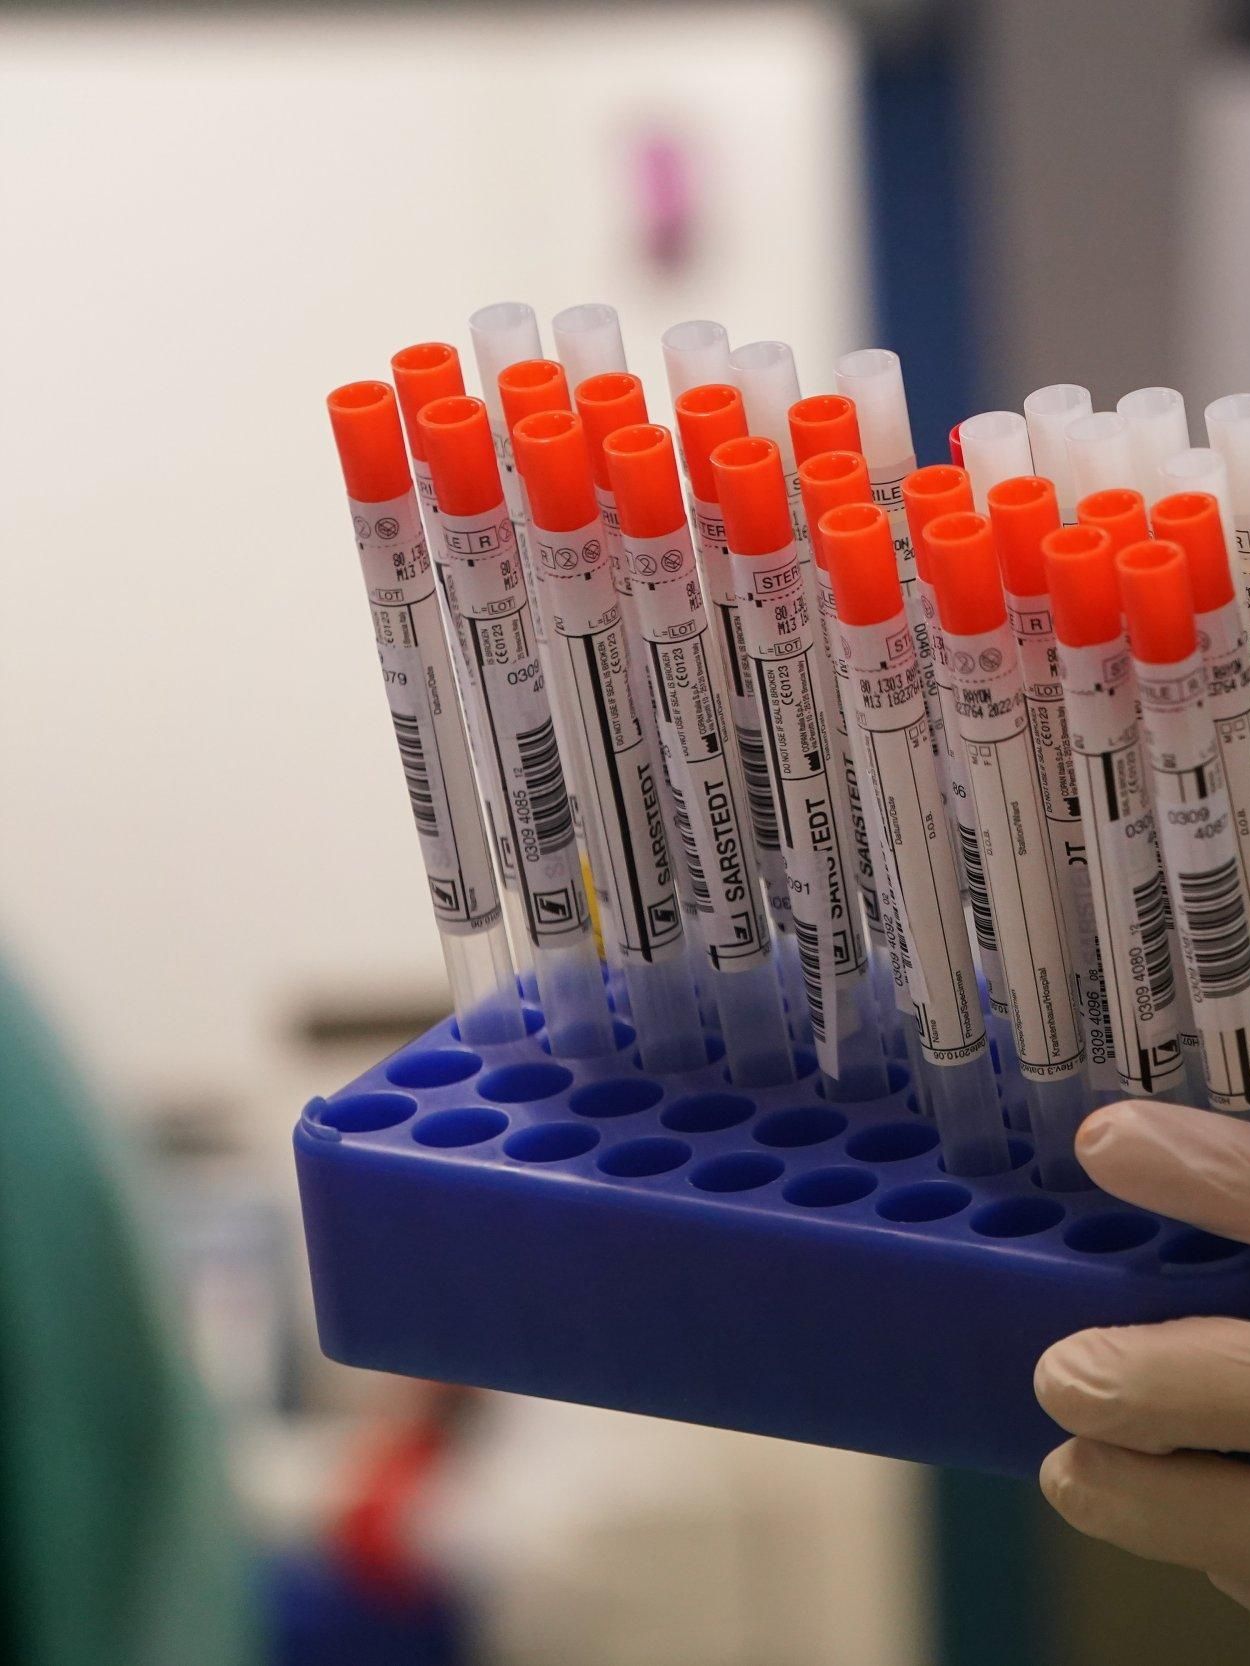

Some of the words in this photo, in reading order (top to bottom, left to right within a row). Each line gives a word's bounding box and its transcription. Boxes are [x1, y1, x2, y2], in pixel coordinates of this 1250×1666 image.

[480, 536, 492, 548] R
[670, 623, 694, 636] LOT
[734, 616, 746, 645] BROKEN
[1030, 618, 1042, 630] R
[481, 629, 493, 660] BROKEN
[777, 640, 799, 654] LOT
[914, 622, 930, 658] 0046
[598, 642, 610, 671] BROKEN
[662, 652, 674, 680] BROKEN
[507, 659, 539, 685] 0309
[766, 670, 778, 699] BROKEN
[605, 678, 616, 698] SEAL
[670, 689, 680, 710] SEAL
[1036, 686, 1060, 696] LOT
[610, 705, 619, 720] USE
[676, 716, 684, 729] USE
[774, 708, 783, 726] SEAL
[612, 720, 622, 737] NOT
[778, 734, 787, 748] USE
[800, 732, 810, 753] COPAN
[780, 748, 789, 762] NOT
[784, 764, 791, 774] DO
[513, 790, 530, 824] 4085
[637, 762, 672, 887] SARSTEDT
[925, 810, 937, 840] D.O.B.
[1009, 800, 1026, 856] Station/Ward
[521, 828, 540, 862] 0309
[704, 780, 746, 902] SARSTEDT
[1088, 968, 1098, 982] 08
[1129, 946, 1146, 982] 4080
[955, 970, 973, 1038] Probe/Specimen
[1038, 968, 1060, 1058] Krankenhaus/Hospital
[1086, 991, 1102, 1026] 4096
[1136, 986, 1154, 1022] 0309
[1092, 1030, 1106, 1064] 0309
